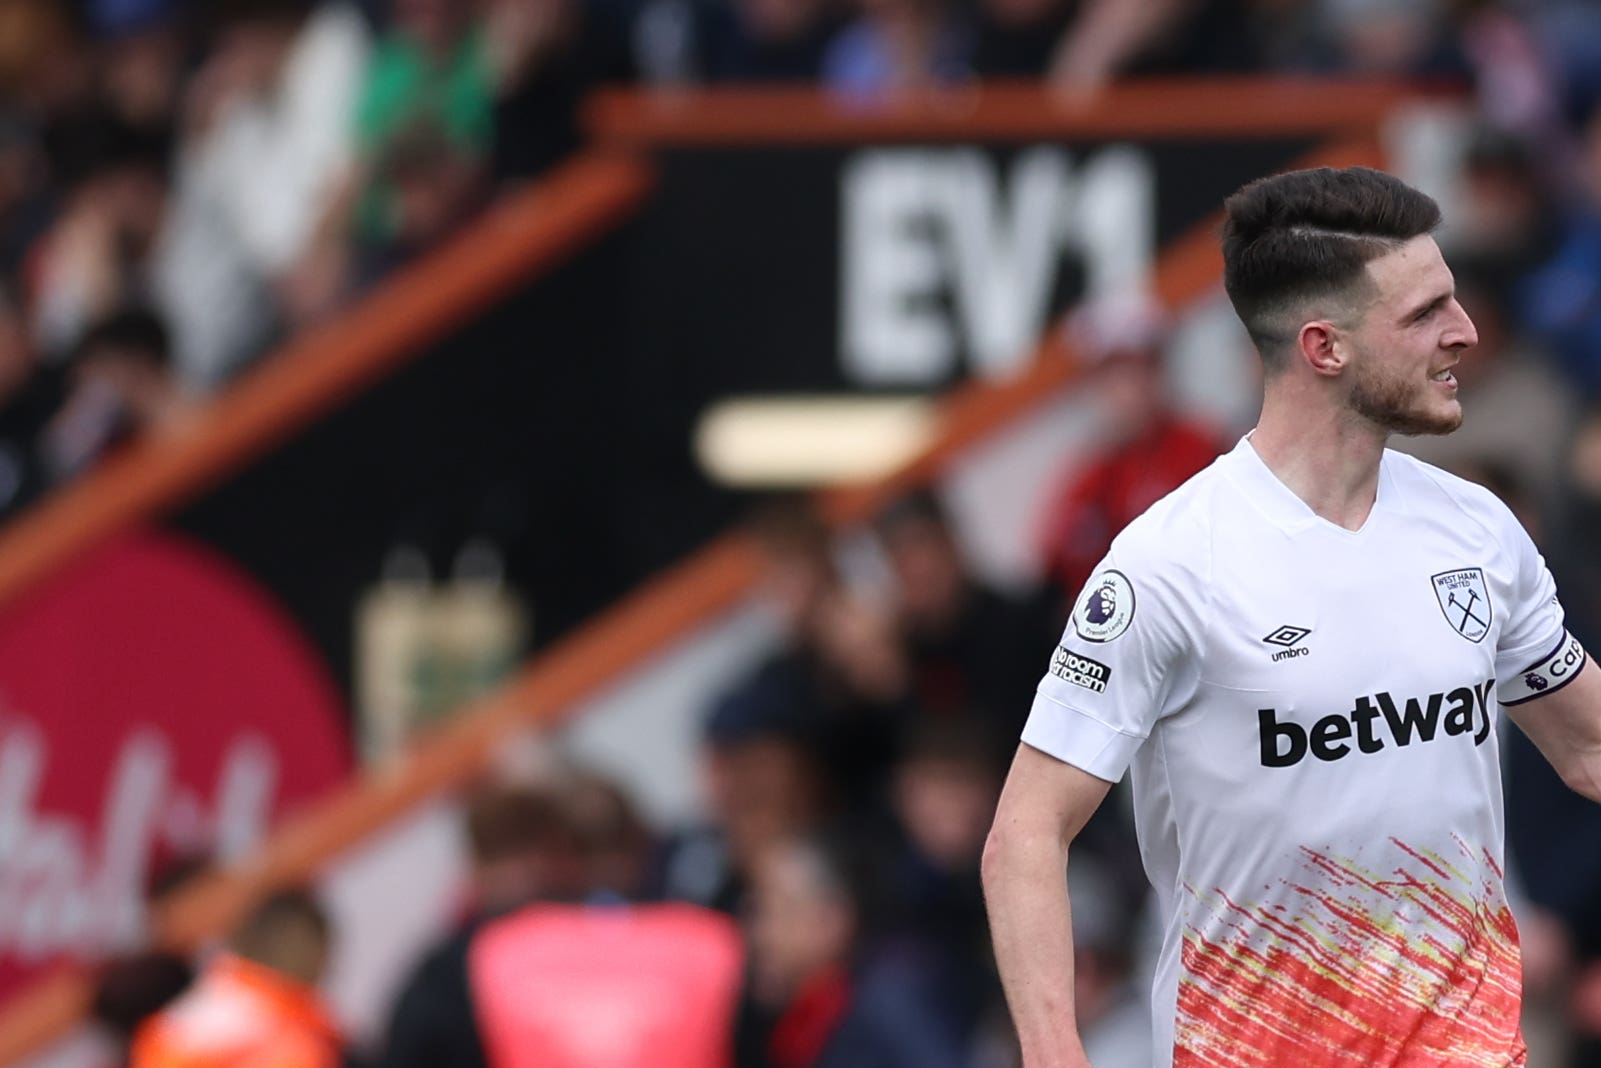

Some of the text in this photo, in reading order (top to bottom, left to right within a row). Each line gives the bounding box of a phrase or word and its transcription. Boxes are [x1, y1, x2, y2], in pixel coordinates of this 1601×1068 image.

[1436, 572, 1478, 586] WEST HAM
[1271, 646, 1310, 662] umbro
[1066, 655, 1104, 678] room
[1060, 667, 1106, 692] racism
[1257, 678, 1496, 768] betway
